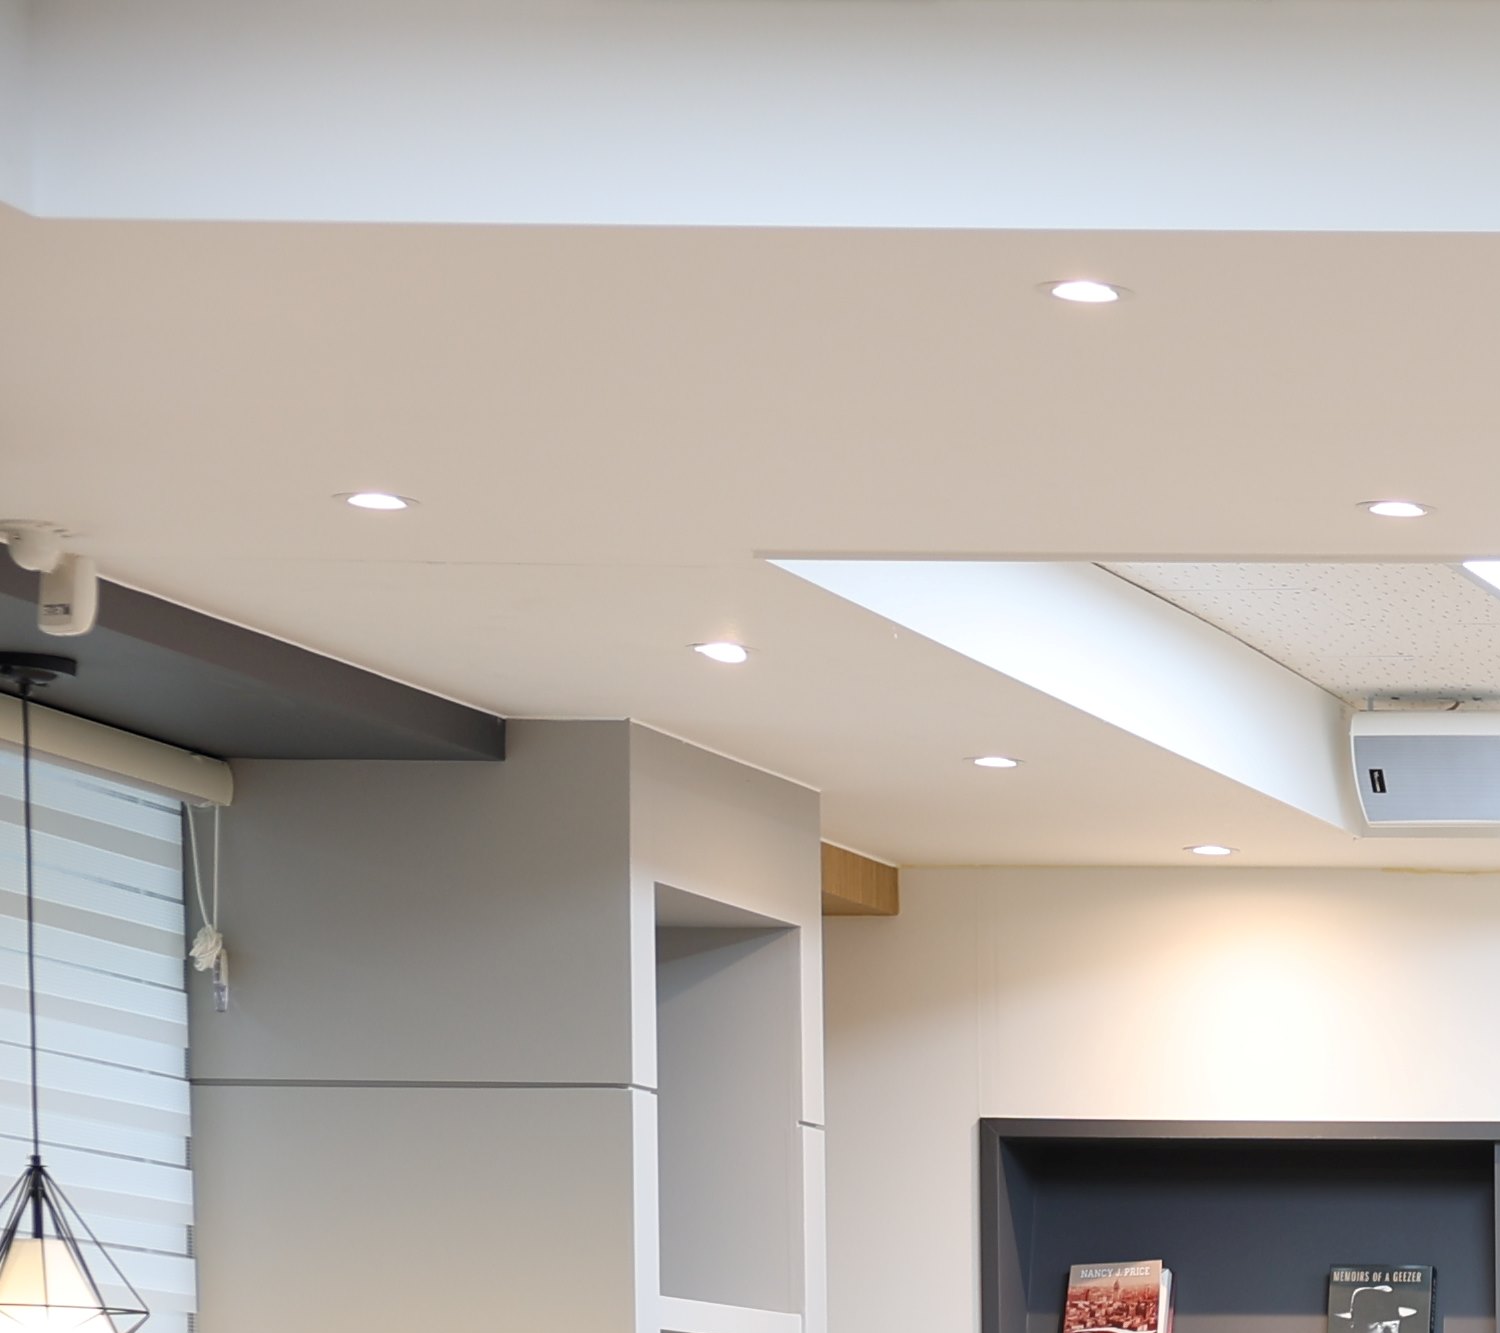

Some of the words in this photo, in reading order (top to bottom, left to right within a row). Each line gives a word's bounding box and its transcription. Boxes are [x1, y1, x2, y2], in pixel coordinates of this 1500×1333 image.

[1080, 1268, 1114, 1279] NANCY
[1124, 1266, 1151, 1277] PRICE
[1333, 1271, 1370, 1282] MEMOIRS
[1392, 1271, 1422, 1283] GEEZER
